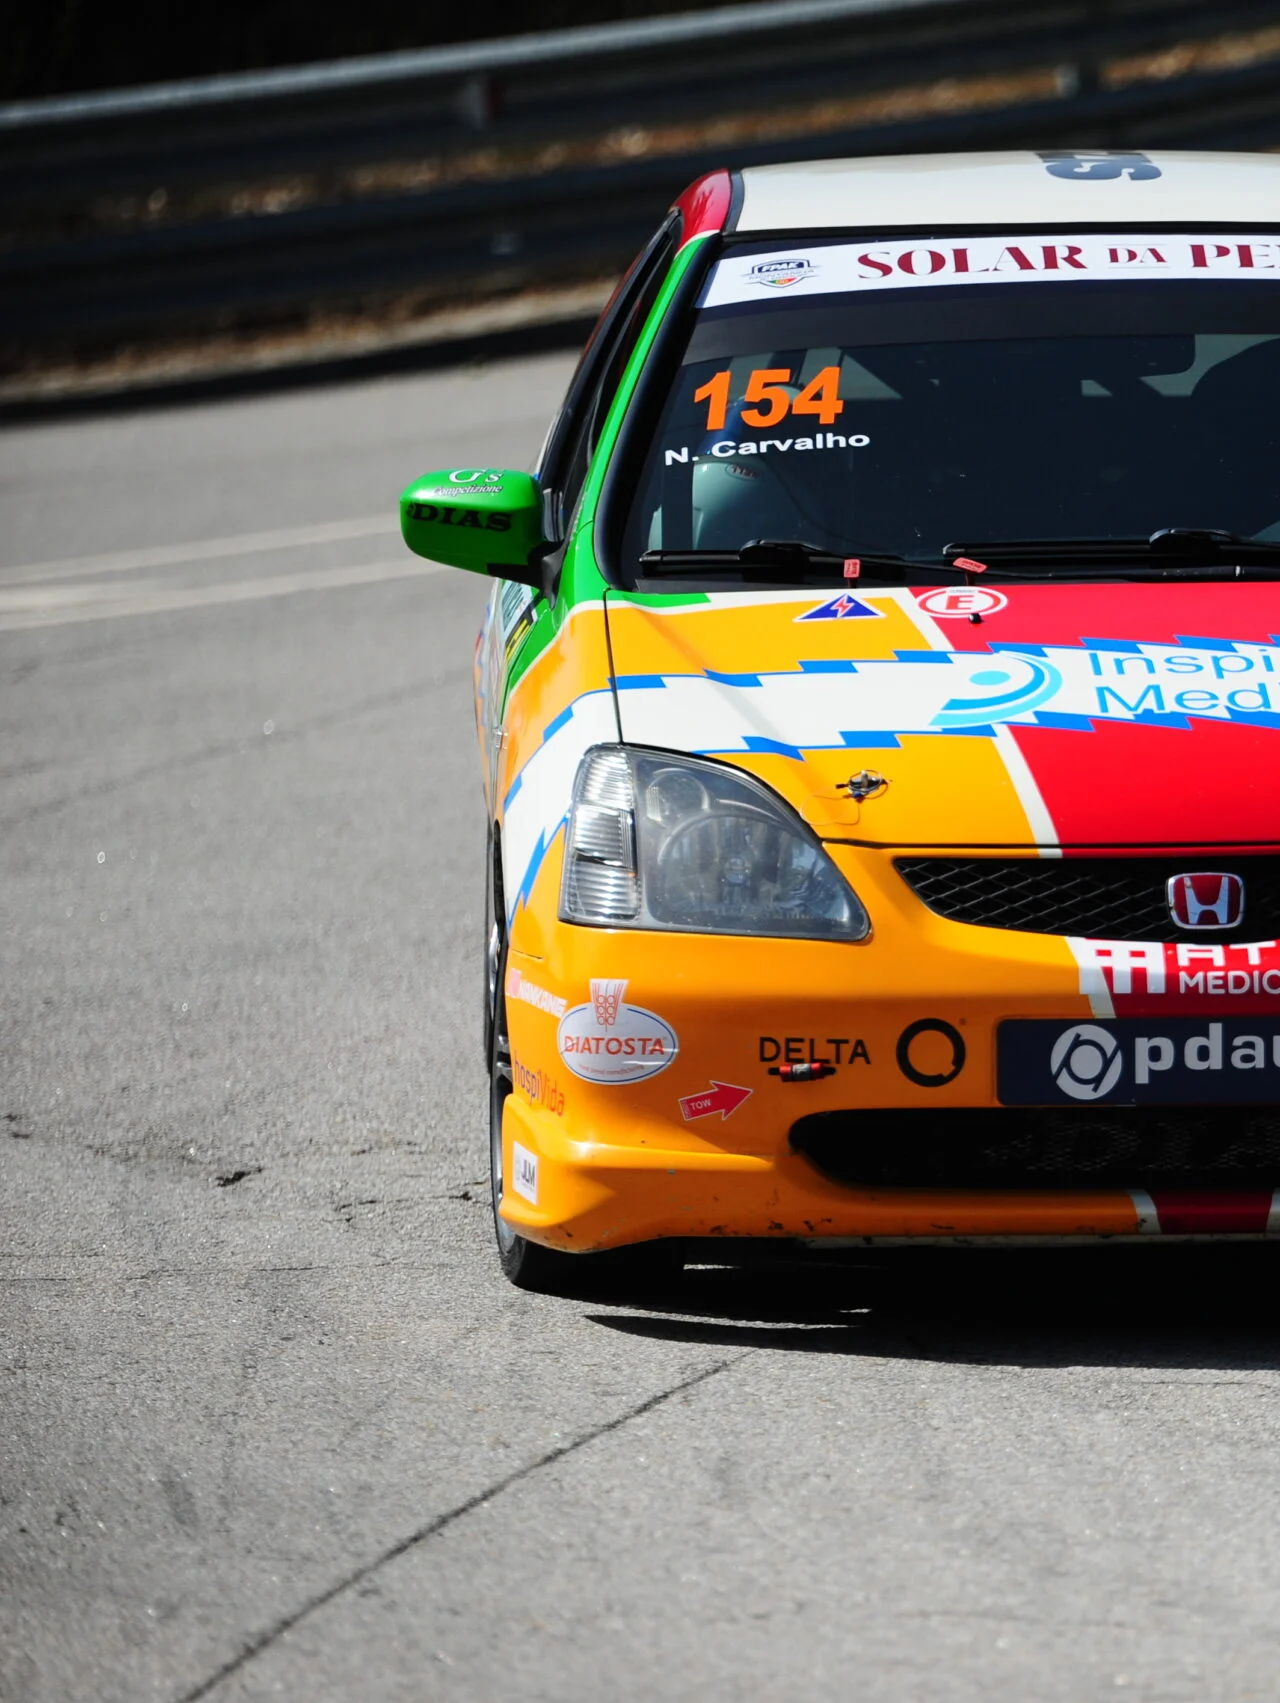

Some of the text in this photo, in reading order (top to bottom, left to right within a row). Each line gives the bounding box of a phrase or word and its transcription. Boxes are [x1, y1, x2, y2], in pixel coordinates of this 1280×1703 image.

[858, 244, 1088, 279] SOLAR
[1107, 247, 1168, 263] DA
[694, 366, 844, 431] 154
[665, 432, 870, 466] N. Carvalho
[411, 502, 513, 532] DIAS
[945, 595, 975, 610] E
[564, 1035, 666, 1056] DIATOSTA
[759, 1037, 871, 1065] DELTA
[690, 1098, 712, 1112] TOW
